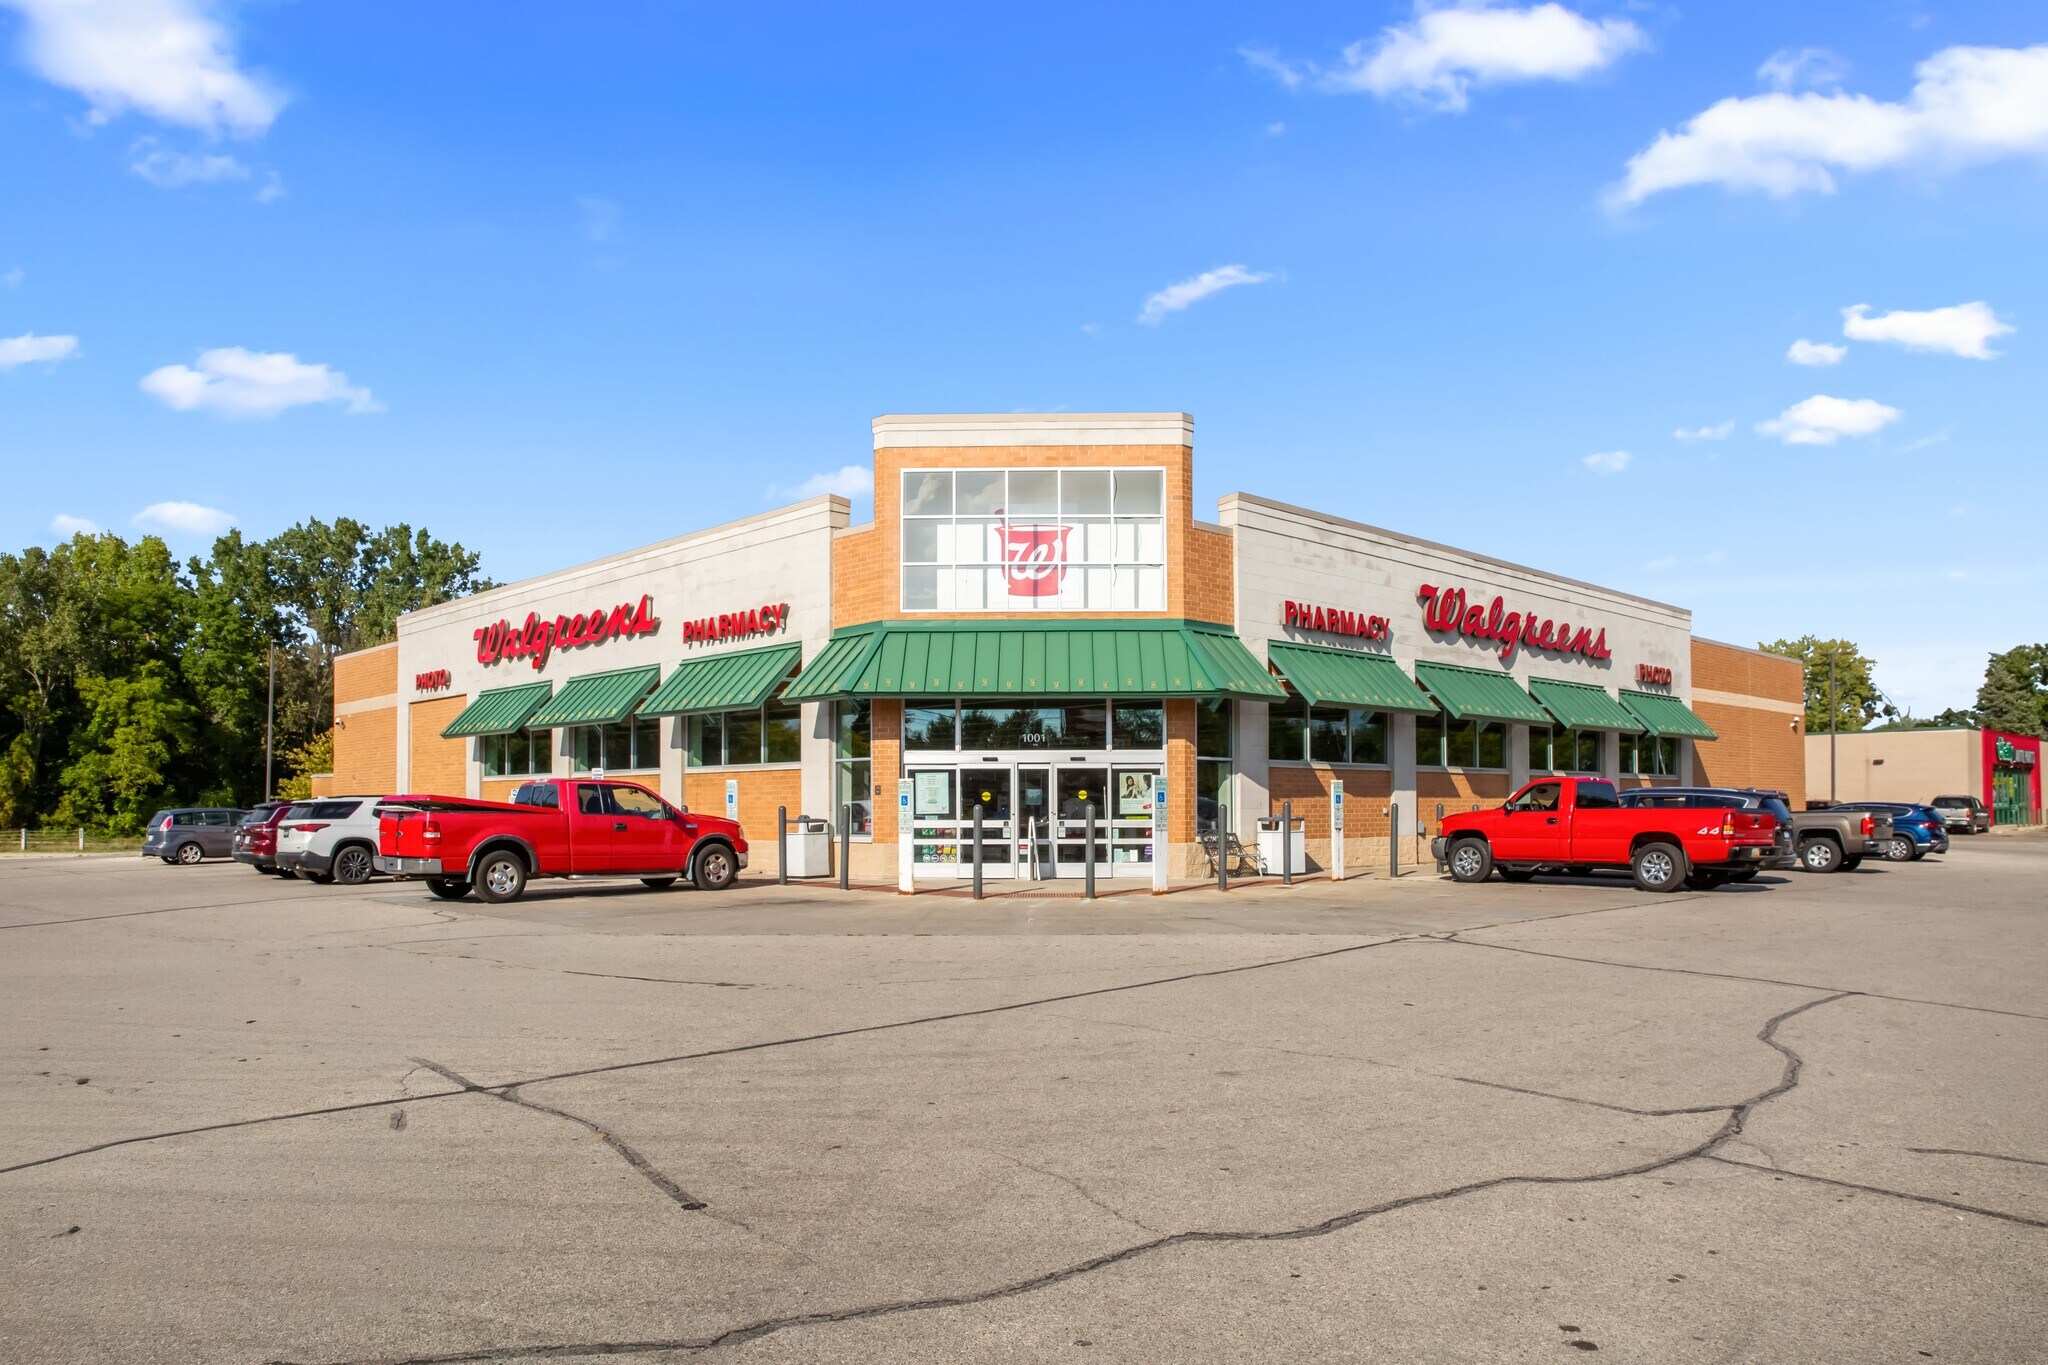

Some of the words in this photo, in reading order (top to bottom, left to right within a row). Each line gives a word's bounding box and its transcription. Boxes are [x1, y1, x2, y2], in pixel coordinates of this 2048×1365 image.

[473, 593, 656, 670] Walgreens
[682, 602, 786, 645] PHARMACY
[1284, 600, 1391, 640] PHARMACY
[1419, 583, 1612, 659] Walgreens
[415, 668, 447, 691] PHOTO
[1639, 663, 1672, 685] PHOTO
[1022, 733, 1046, 743] 1001
